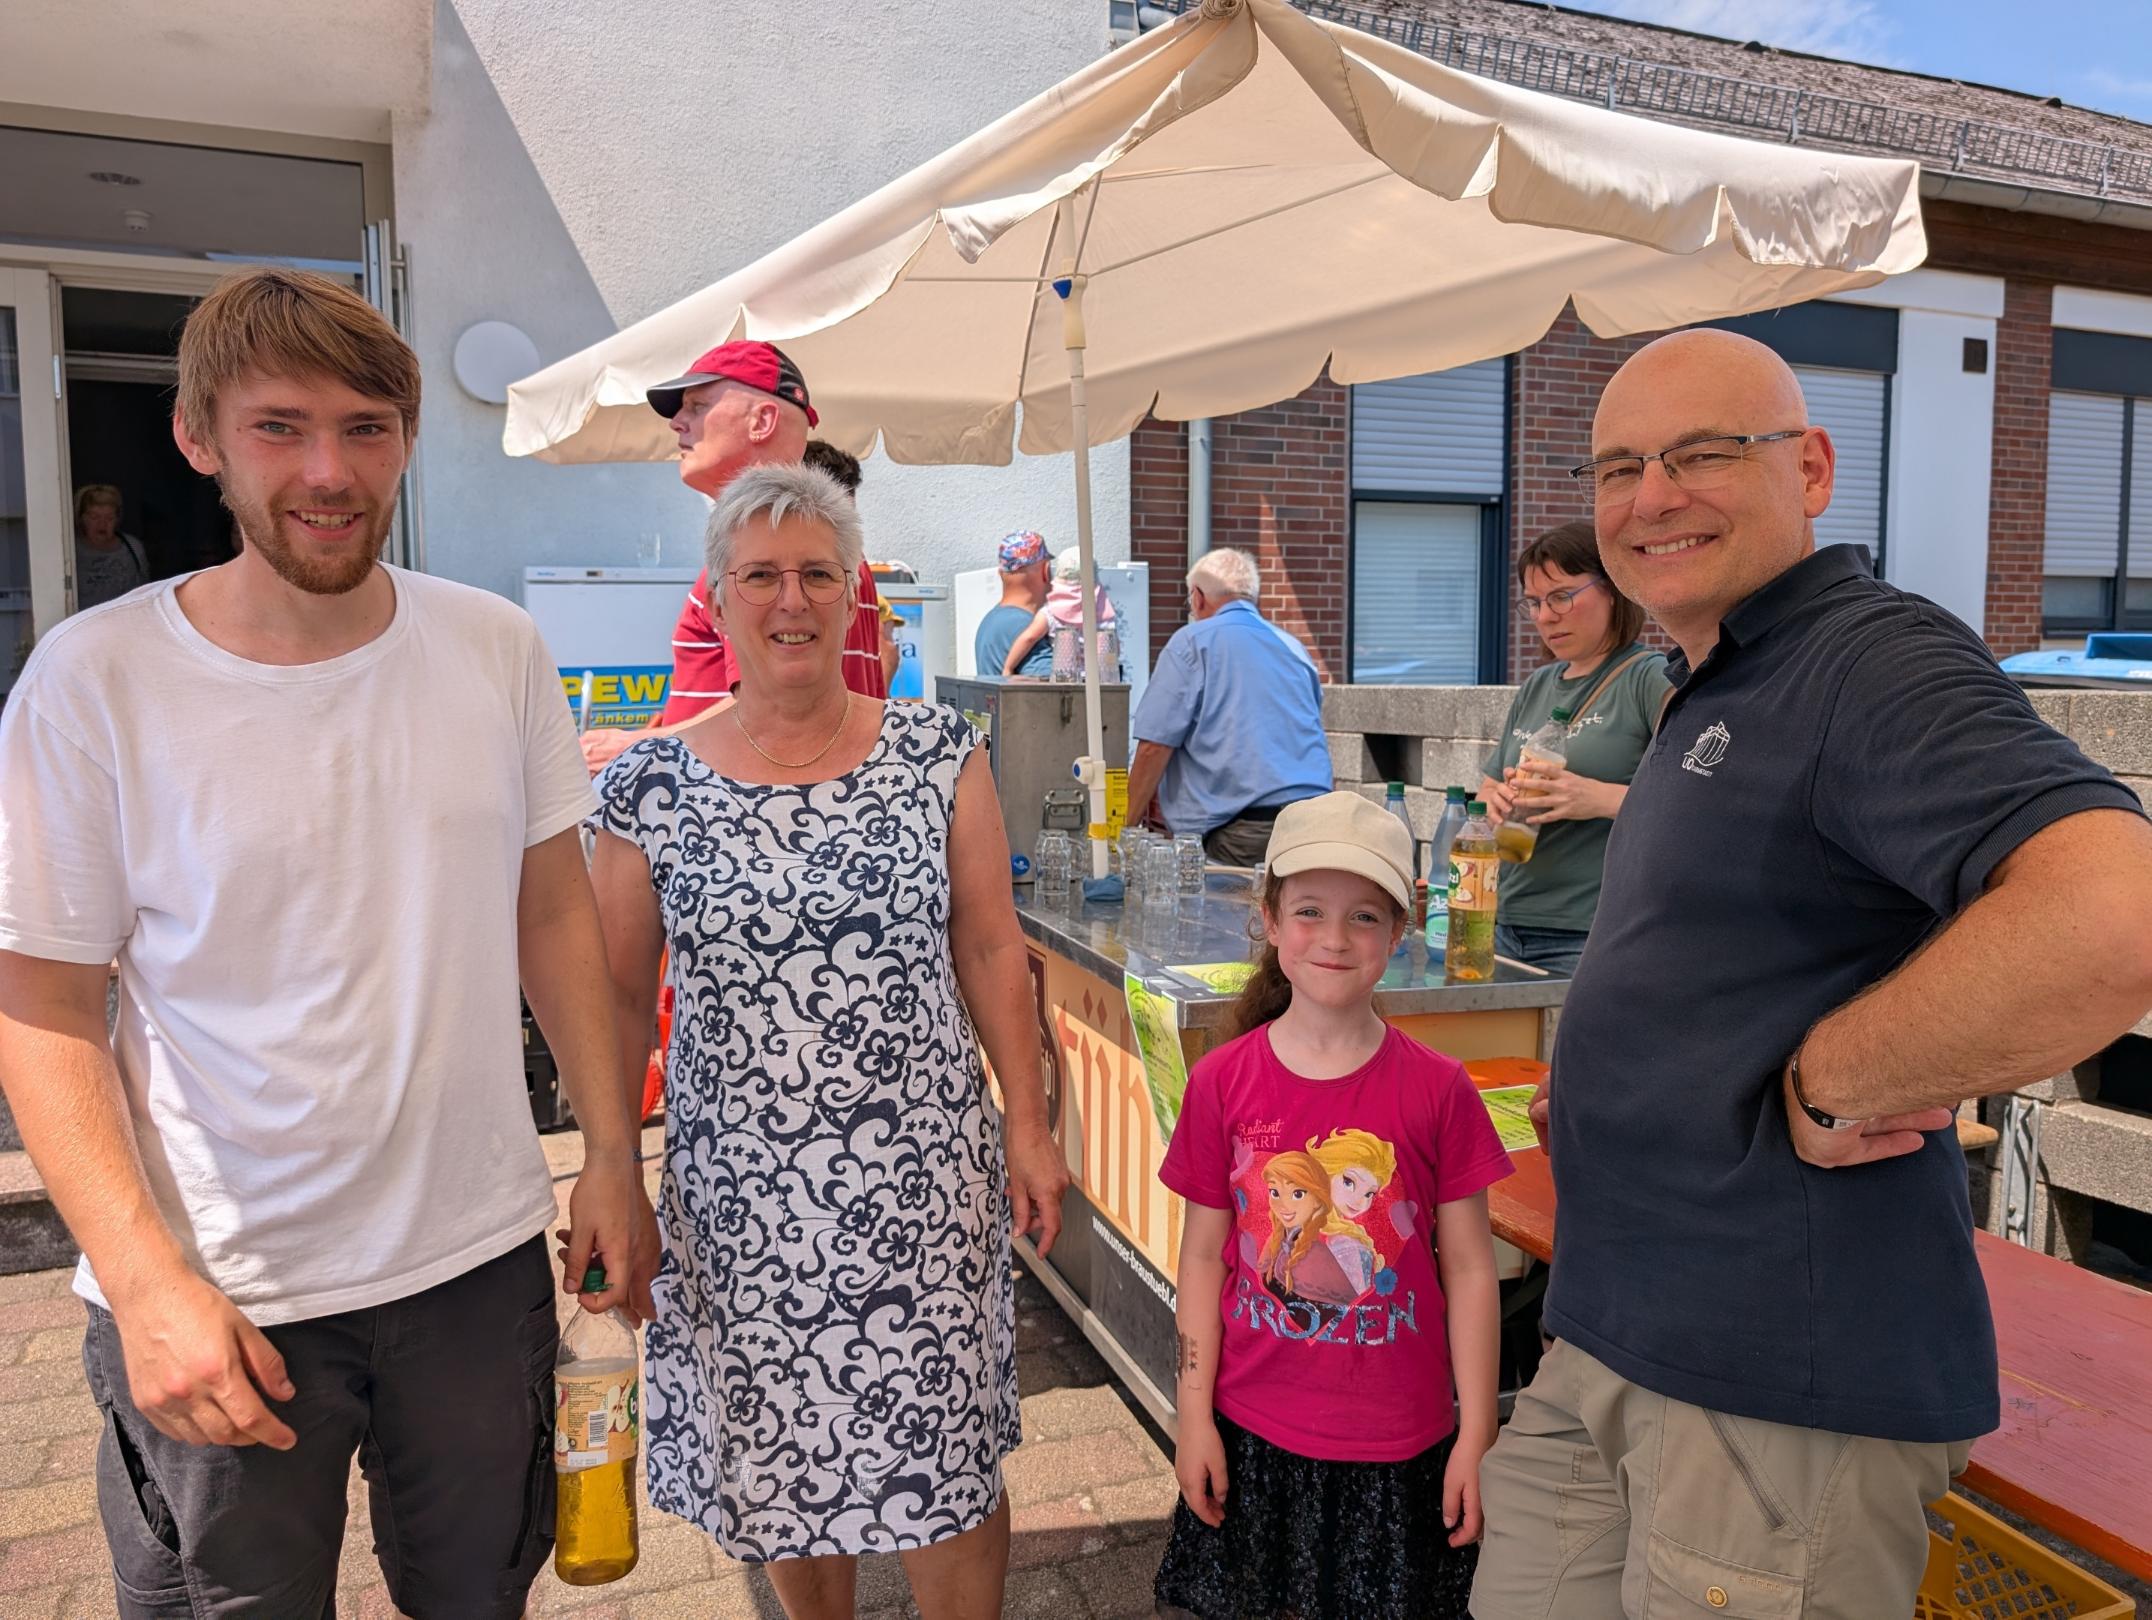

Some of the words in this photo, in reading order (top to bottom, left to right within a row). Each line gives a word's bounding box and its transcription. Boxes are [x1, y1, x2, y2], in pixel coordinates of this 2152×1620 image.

[561, 674, 673, 702] PEW
[1237, 1118, 1284, 1137] Radiant
[1232, 1276, 1421, 1345] FROZEN
